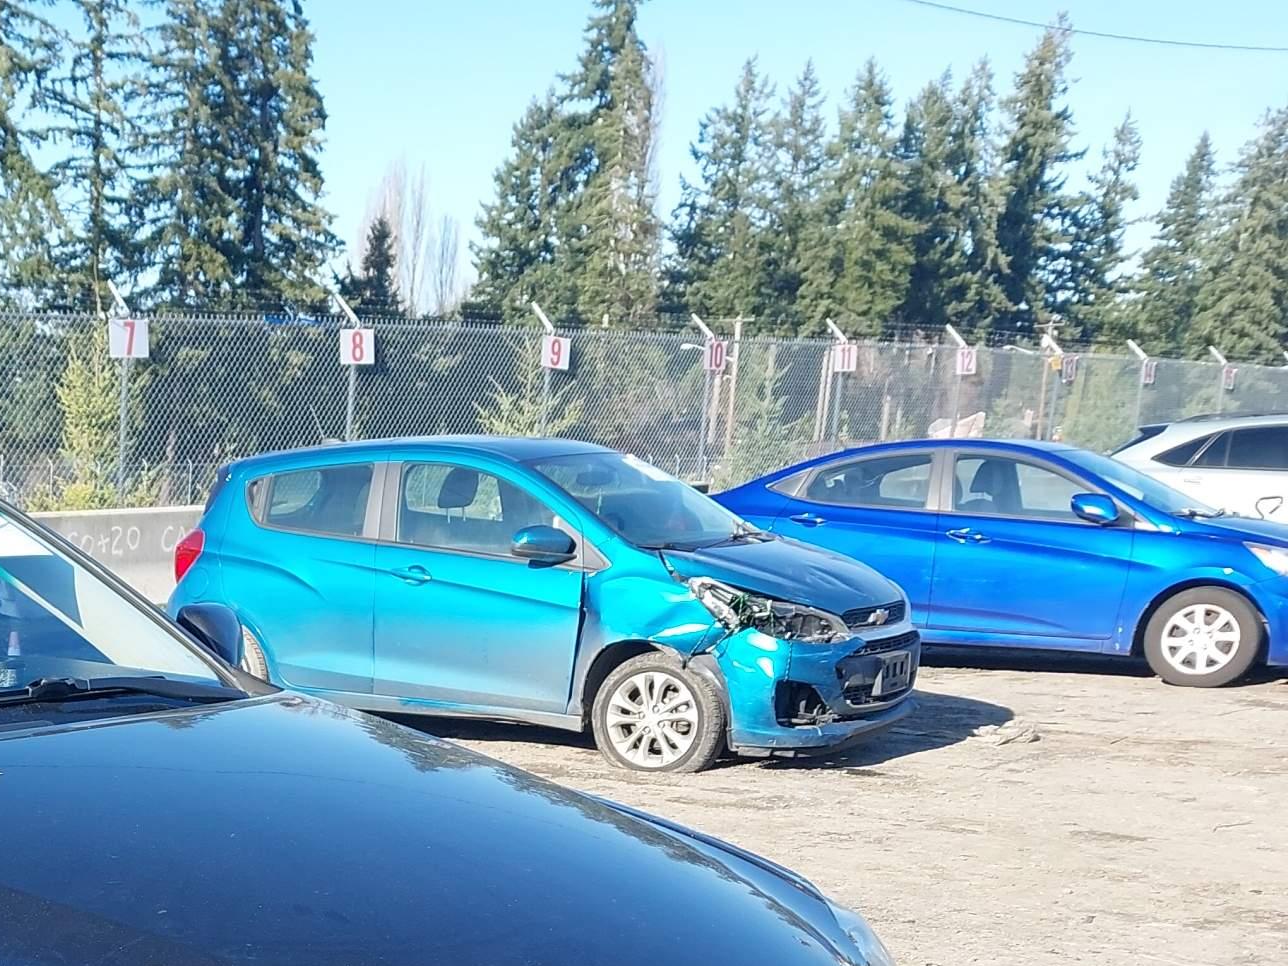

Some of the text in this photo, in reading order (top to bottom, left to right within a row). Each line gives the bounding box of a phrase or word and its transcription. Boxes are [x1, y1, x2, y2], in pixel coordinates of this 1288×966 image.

[123, 320, 136, 356] 7
[352, 331, 364, 362] 8
[550, 338, 562, 366] 9
[709, 342, 723, 369] 10
